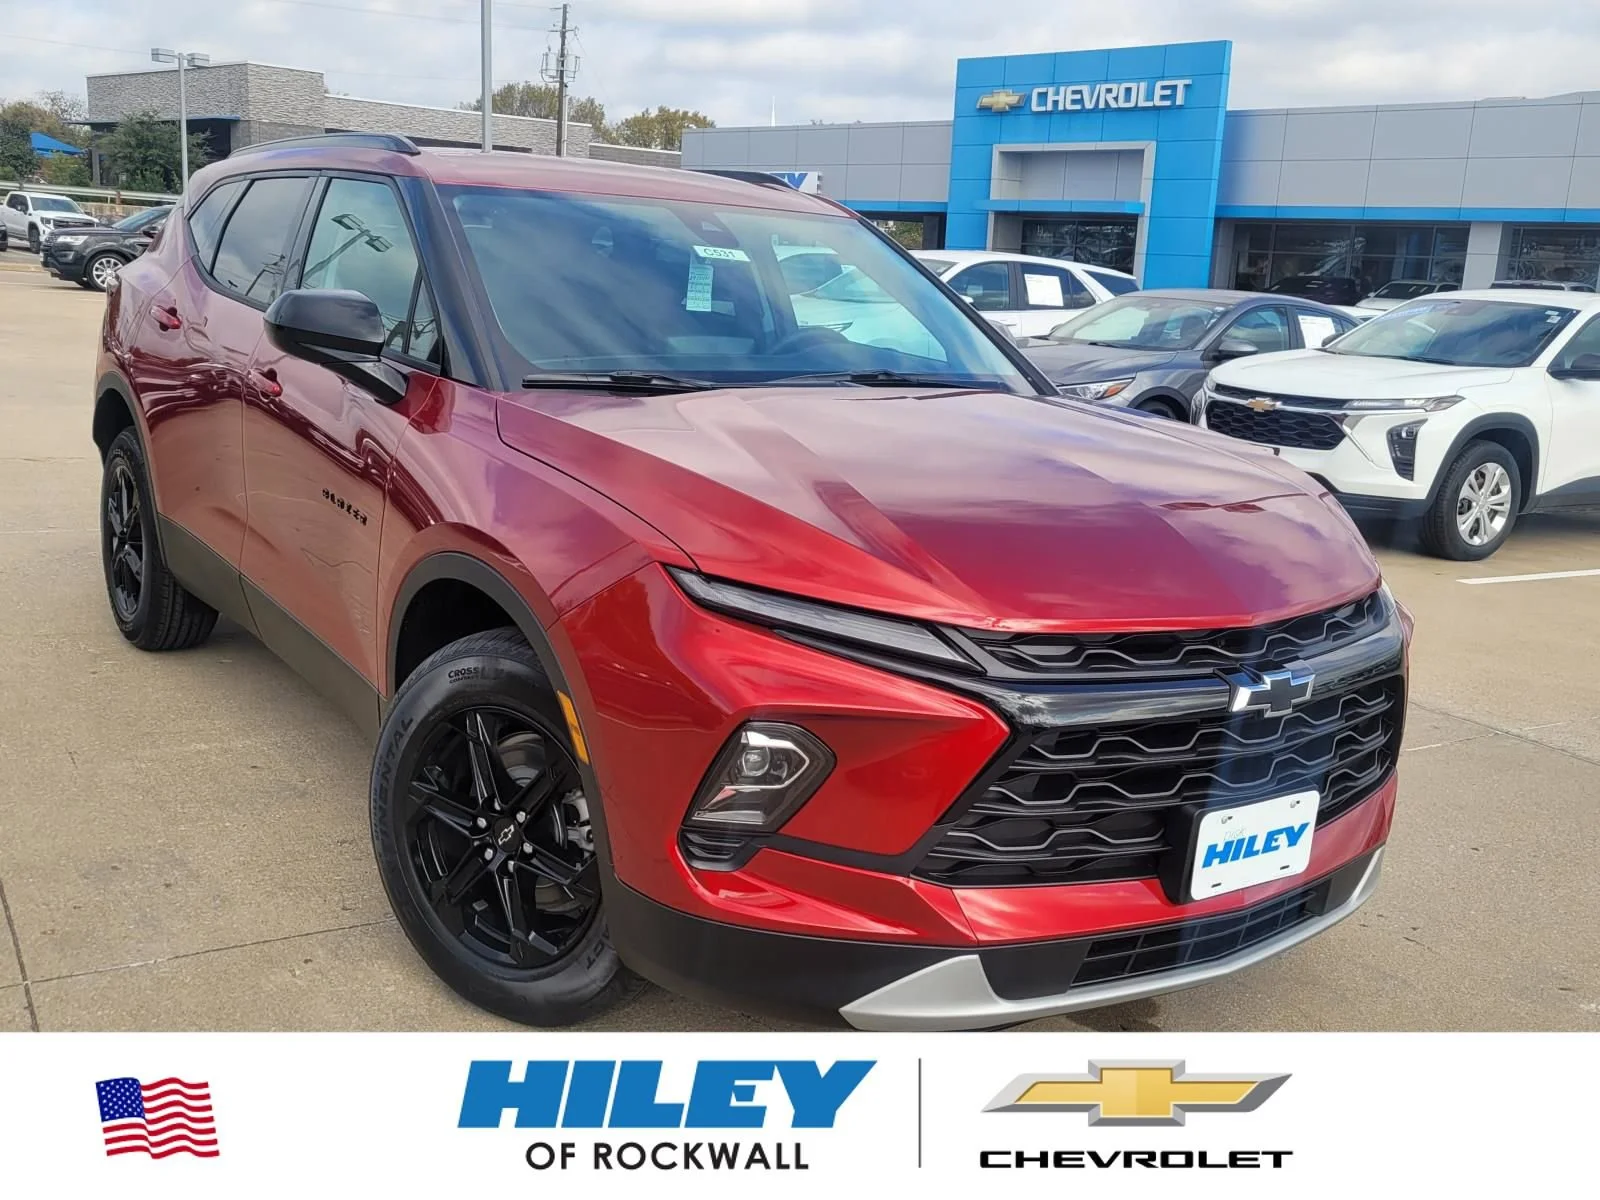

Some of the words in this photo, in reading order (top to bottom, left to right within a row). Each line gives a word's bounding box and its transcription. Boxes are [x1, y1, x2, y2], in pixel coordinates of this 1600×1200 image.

[1031, 79, 1192, 112] CHEVROLET
[703, 247, 736, 258] C531
[447, 666, 480, 679] CROSS
[1202, 822, 1310, 869] HILEY
